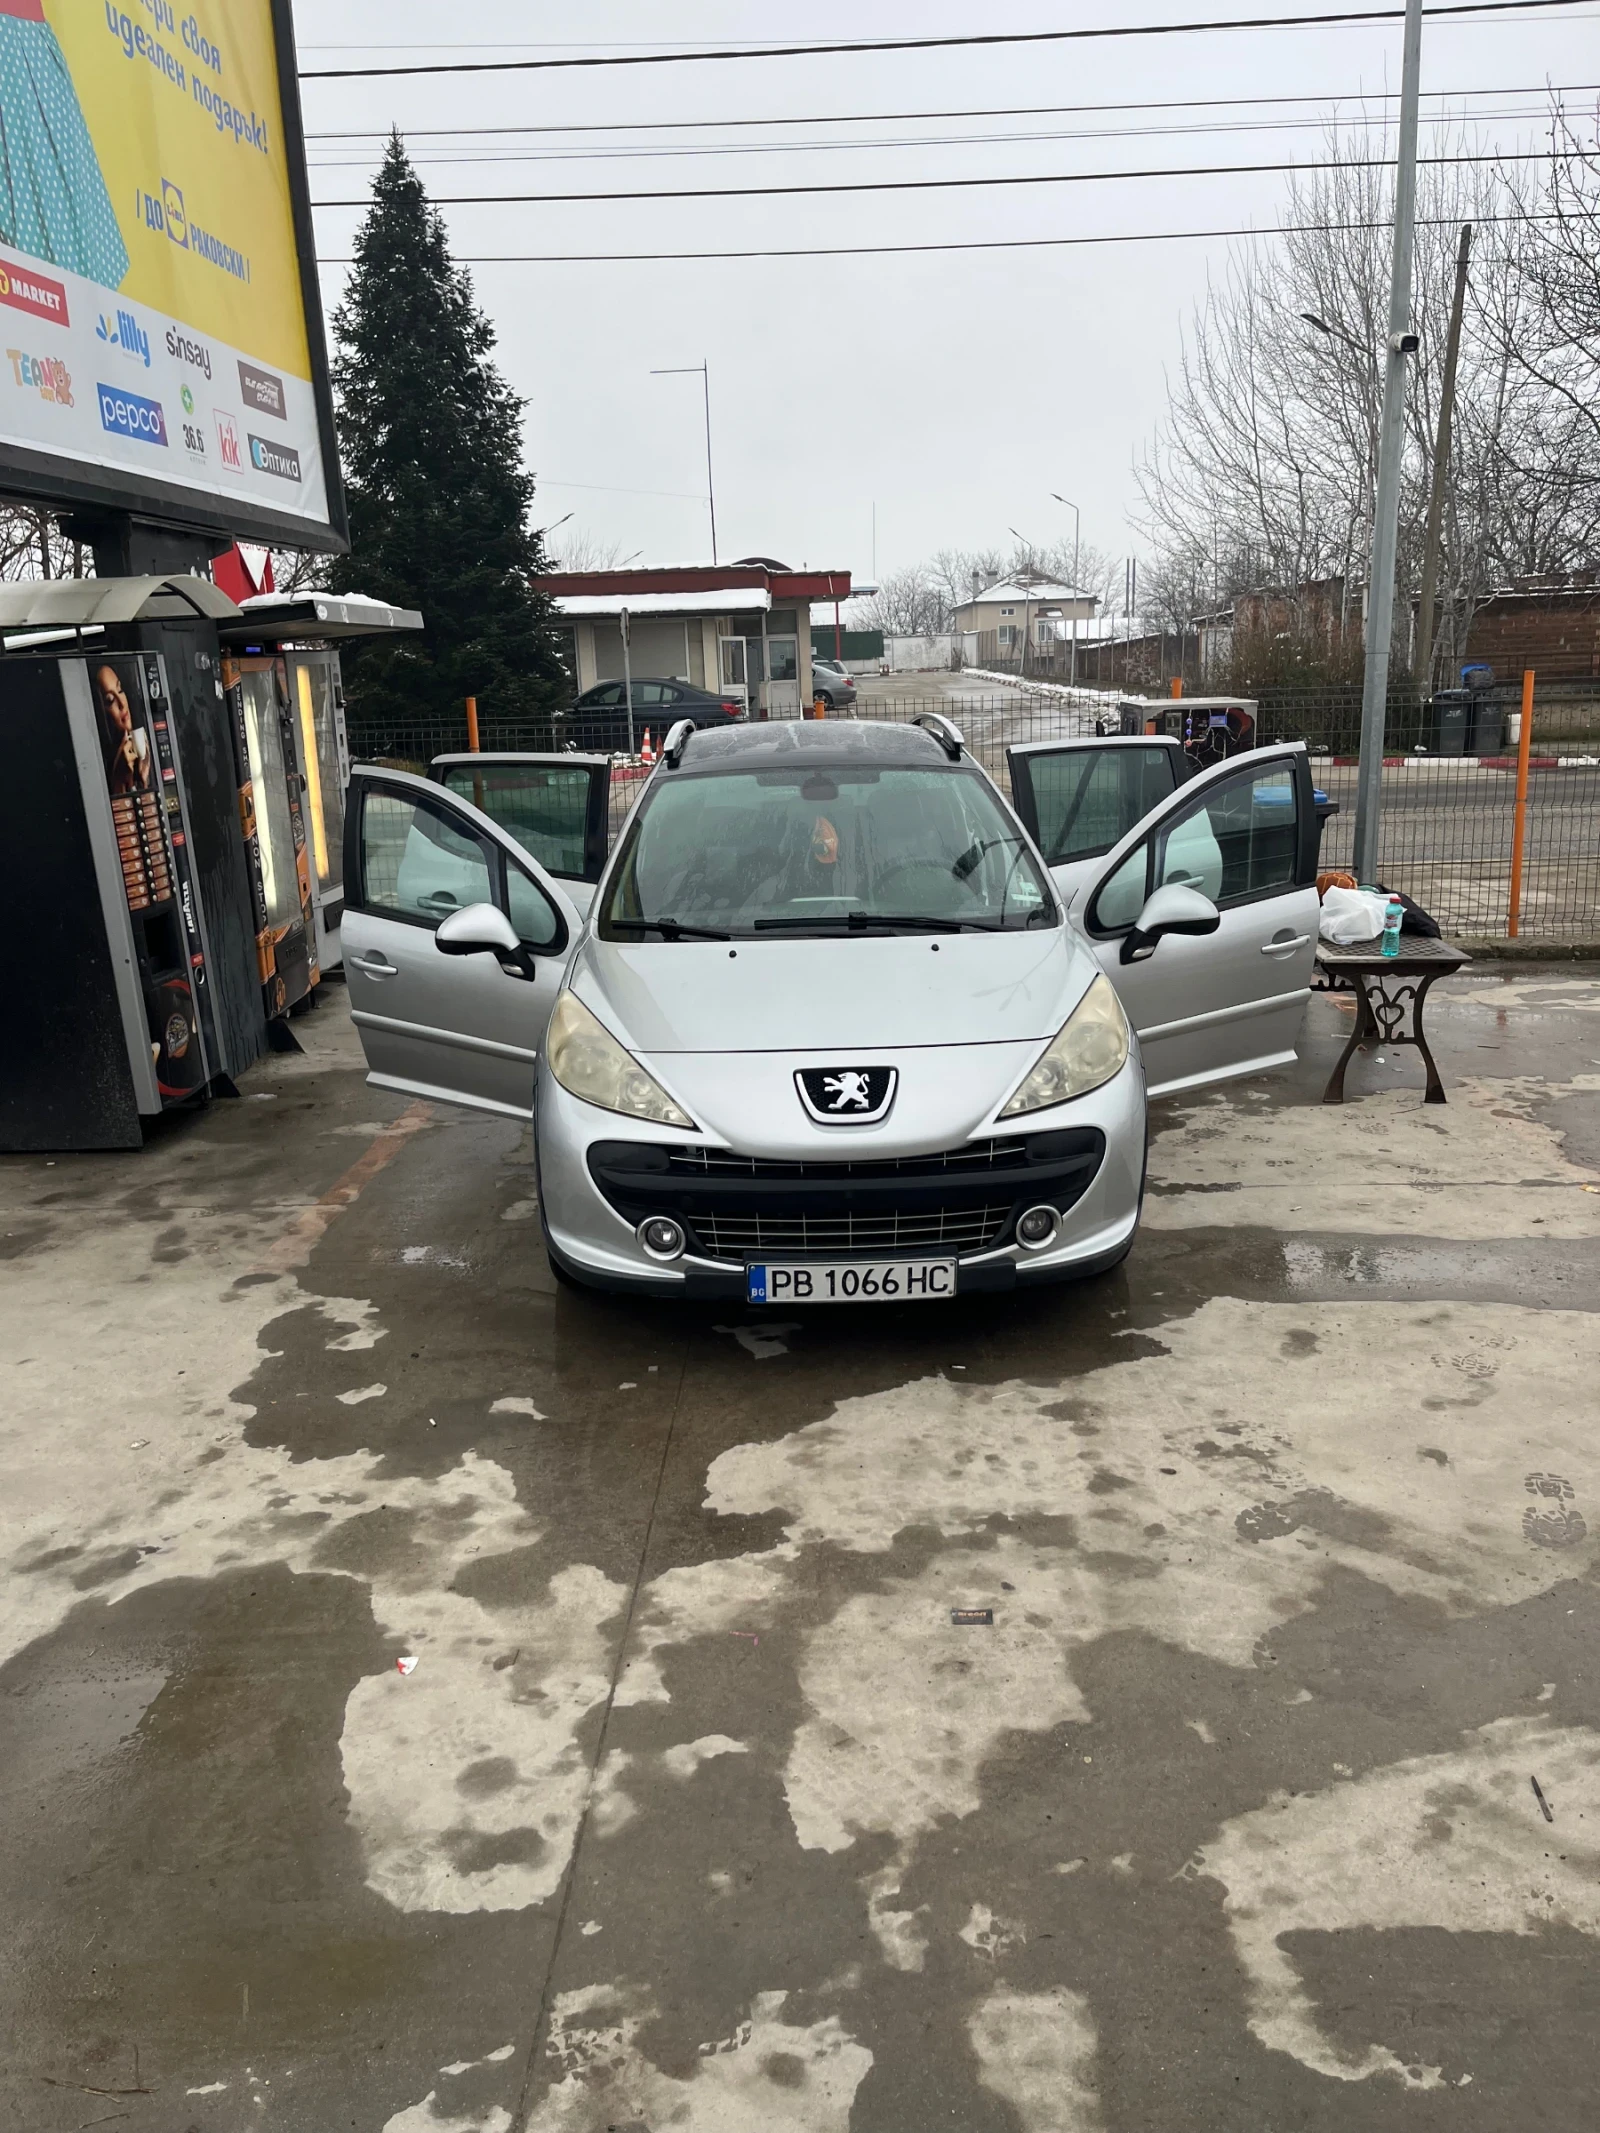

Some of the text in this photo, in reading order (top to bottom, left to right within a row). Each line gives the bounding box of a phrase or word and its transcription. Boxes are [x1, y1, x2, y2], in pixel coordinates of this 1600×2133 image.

[181, 15, 221, 75] своя
[105, 0, 268, 154] идеален подарък!
[144, 193, 164, 231] ДО
[189, 222, 246, 281] РАКОВСКИ
[11, 276, 60, 311] MARKET
[116, 309, 151, 368] lilly
[165, 325, 212, 381] sinsay
[102, 395, 161, 435] pepco
[235, 685, 246, 739] VENDING
[251, 835, 261, 869] NON
[751, 1287, 765, 1297] BG
[771, 1265, 949, 1298] PB 1066 HC
